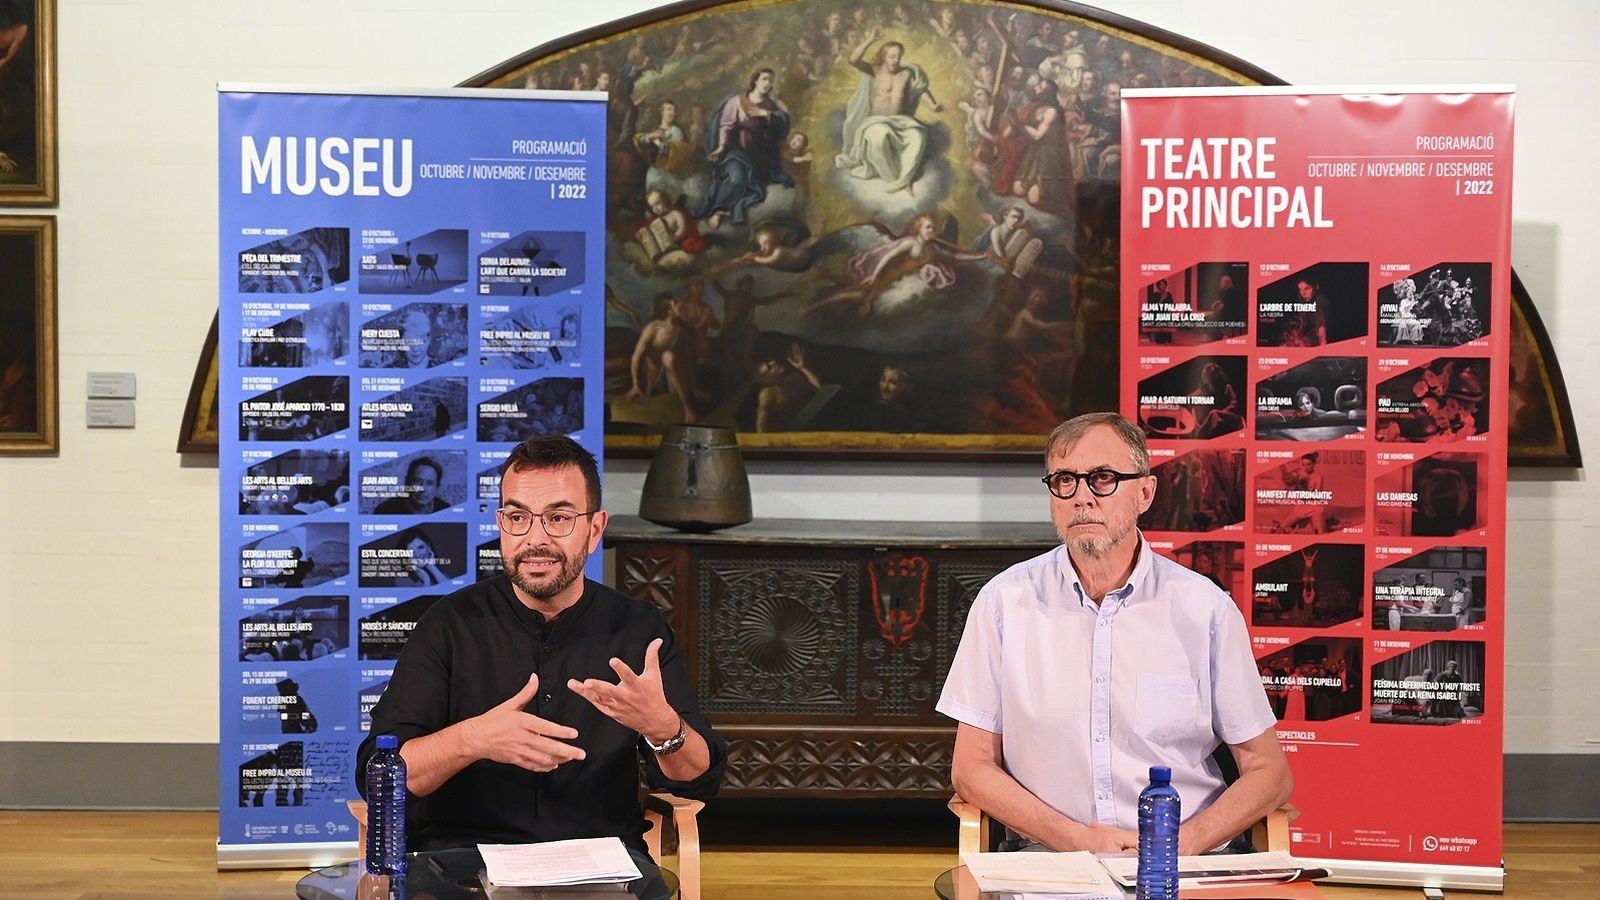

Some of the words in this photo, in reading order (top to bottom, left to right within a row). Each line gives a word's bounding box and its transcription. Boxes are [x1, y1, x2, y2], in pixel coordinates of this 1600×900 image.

[1416, 133, 1494, 151] PROGRAMACIÓ
[513, 139, 586, 155] PROGRAMACIÓ
[1140, 137, 1276, 180] TEATRE
[241, 136, 412, 197] MUSEU
[1308, 163, 1357, 177] OCTUBRE
[1367, 163, 1426, 177] NOVEMBRE
[1436, 162, 1494, 177] DESEMBRE
[420, 164, 465, 178] OCTUBRE
[473, 165, 526, 180] NOVEMBRE
[535, 167, 586, 181] DESEMBRE
[559, 185, 586, 198] 2022
[1464, 181, 1493, 195] 2022
[1142, 185, 1333, 228] PRINCIPAL
[242, 254, 257, 263] PEÇA
[258, 254, 269, 263] DEL
[270, 254, 301, 263] TRIMESTRE
[480, 257, 498, 266] SONIA
[480, 268, 495, 276] L'ART
[496, 268, 508, 276] QUE
[509, 268, 531, 276] CANVIA
[532, 268, 539, 276] LA
[540, 268, 567, 276] SOCIETAT
[1141, 303, 1158, 311] ALMA
[1260, 303, 1283, 312] L'ARBRE
[1284, 303, 1292, 312] DE
[1294, 301, 1316, 312] TENERÉ
[1380, 304, 1398, 314] ¡VIVA!
[1141, 313, 1154, 321] SAN
[1155, 313, 1171, 321] JUAN
[1172, 313, 1180, 321] DE
[1181, 313, 1188, 321] LA
[1190, 313, 1205, 321] CRUZ
[242, 329, 257, 337] PLAY
[258, 329, 274, 337] CUBE
[362, 329, 377, 338] MERY
[378, 329, 400, 338] CUESTA
[480, 331, 495, 339] FREE
[495, 331, 513, 339] IMPRO
[514, 331, 521, 339] AL
[522, 331, 542, 339] MUSEU
[1140, 396, 1157, 404] ANAR
[1164, 396, 1186, 404] SATURN
[1191, 396, 1215, 404] TORNAR
[1258, 397, 1266, 405] LA
[1267, 397, 1292, 405] INFAMIA
[242, 402, 250, 411] EL
[250, 402, 271, 411] PINTOR
[271, 401, 285, 411] JOSÉ
[286, 403, 311, 411] APARICIO
[362, 403, 379, 412] ATLES
[380, 403, 398, 412] MEDIA
[399, 403, 413, 412] VACA
[480, 404, 500, 412] SERGIO
[501, 402, 518, 412] MELIÀ
[242, 476, 253, 485] LES
[254, 476, 268, 485] ARTS
[269, 476, 276, 485] AL
[276, 476, 297, 485] BELLES
[298, 476, 313, 485] ARTS
[362, 476, 377, 485] JUAN
[378, 476, 398, 485] ARNAU
[480, 476, 493, 485] FREE
[1257, 490, 1287, 498] MANIFEST
[1288, 489, 1332, 499] ANTIROMÀNTIC
[1377, 493, 1389, 501] LAS
[1390, 493, 1418, 501] DANESAS
[242, 550, 266, 558] GEORGIA
[267, 550, 294, 558] O'KEEFFE:
[362, 550, 377, 558] ESTIL
[378, 550, 414, 558] CONCERTANT
[242, 560, 251, 568] LA
[251, 560, 265, 568] FLOR
[266, 560, 276, 568] DEL
[277, 560, 298, 568] DESERT
[1255, 583, 1288, 592] AMBULANT
[1390, 585, 1414, 595] TERÀPIA
[1416, 587, 1445, 596] INTEGRAL
[242, 623, 253, 631] LES
[254, 623, 268, 631] ARTS
[269, 623, 276, 631] AL
[276, 623, 297, 631] BELLES
[298, 623, 313, 631] ARTS
[362, 621, 382, 630] MOISÉS
[389, 621, 413, 630] SÁNCHEZ
[1280, 677, 1296, 685] CASA
[1297, 677, 1312, 685] DELS
[1313, 678, 1341, 687] CUPIELLO
[1374, 678, 1398, 688] FEÍSIMA
[1399, 681, 1439, 690] ENFERMEDAD
[1445, 683, 1459, 691] MUY
[1459, 683, 1480, 691] TRISTE
[1374, 690, 1398, 698] MUERTE
[1399, 690, 1407, 698] DE
[1408, 691, 1416, 699] LA
[1417, 691, 1436, 699] REINA
[1437, 691, 1457, 700] ISABEL
[242, 696, 266, 704] FONENT
[267, 696, 297, 704] CREENCES
[1276, 731, 1315, 740] ESPECTACLES
[242, 769, 257, 777] FREE
[258, 769, 276, 777] IMPRO
[277, 769, 285, 777] AL
[285, 769, 305, 777] MUSEU
[1451, 837, 1477, 845] whatsapp
